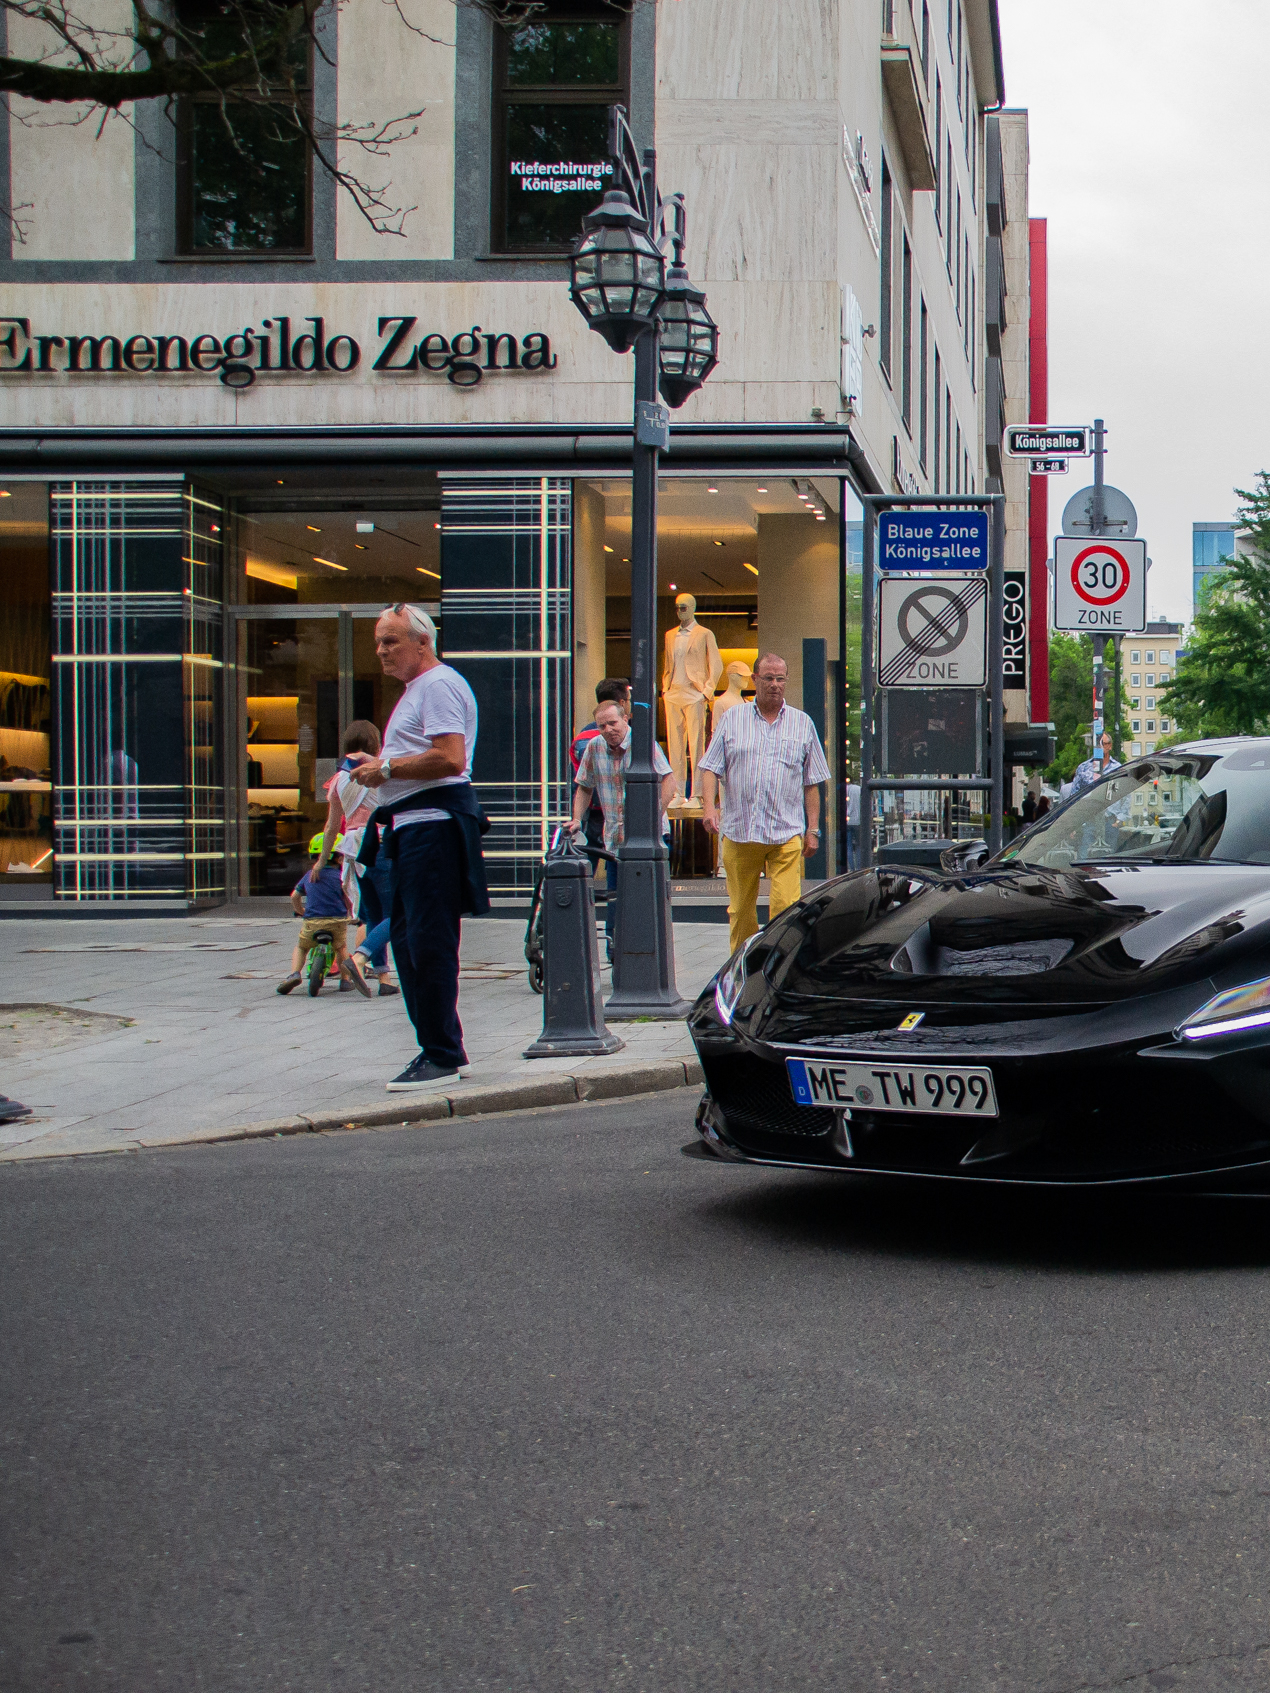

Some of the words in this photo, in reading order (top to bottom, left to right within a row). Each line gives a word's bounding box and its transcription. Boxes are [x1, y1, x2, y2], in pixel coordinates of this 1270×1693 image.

[510, 161, 613, 177] Kieferchirurgie
[522, 178, 602, 193] Königsallee
[0, 316, 361, 389] Ermenegildo
[372, 316, 558, 387] Zegna
[1015, 434, 1079, 451] Königsallee
[1036, 462, 1045, 471] 56
[888, 524, 934, 538] Blaue
[939, 524, 979, 538] Zone
[885, 544, 981, 561] Königsallee
[1083, 562, 1118, 589] 30
[1078, 609, 1122, 625] ZONE
[1002, 581, 1025, 675] PREGO
[906, 663, 959, 679] ZONE
[808, 1067, 854, 1102] ME
[871, 1071, 916, 1106] TW
[924, 1073, 988, 1109] 999
